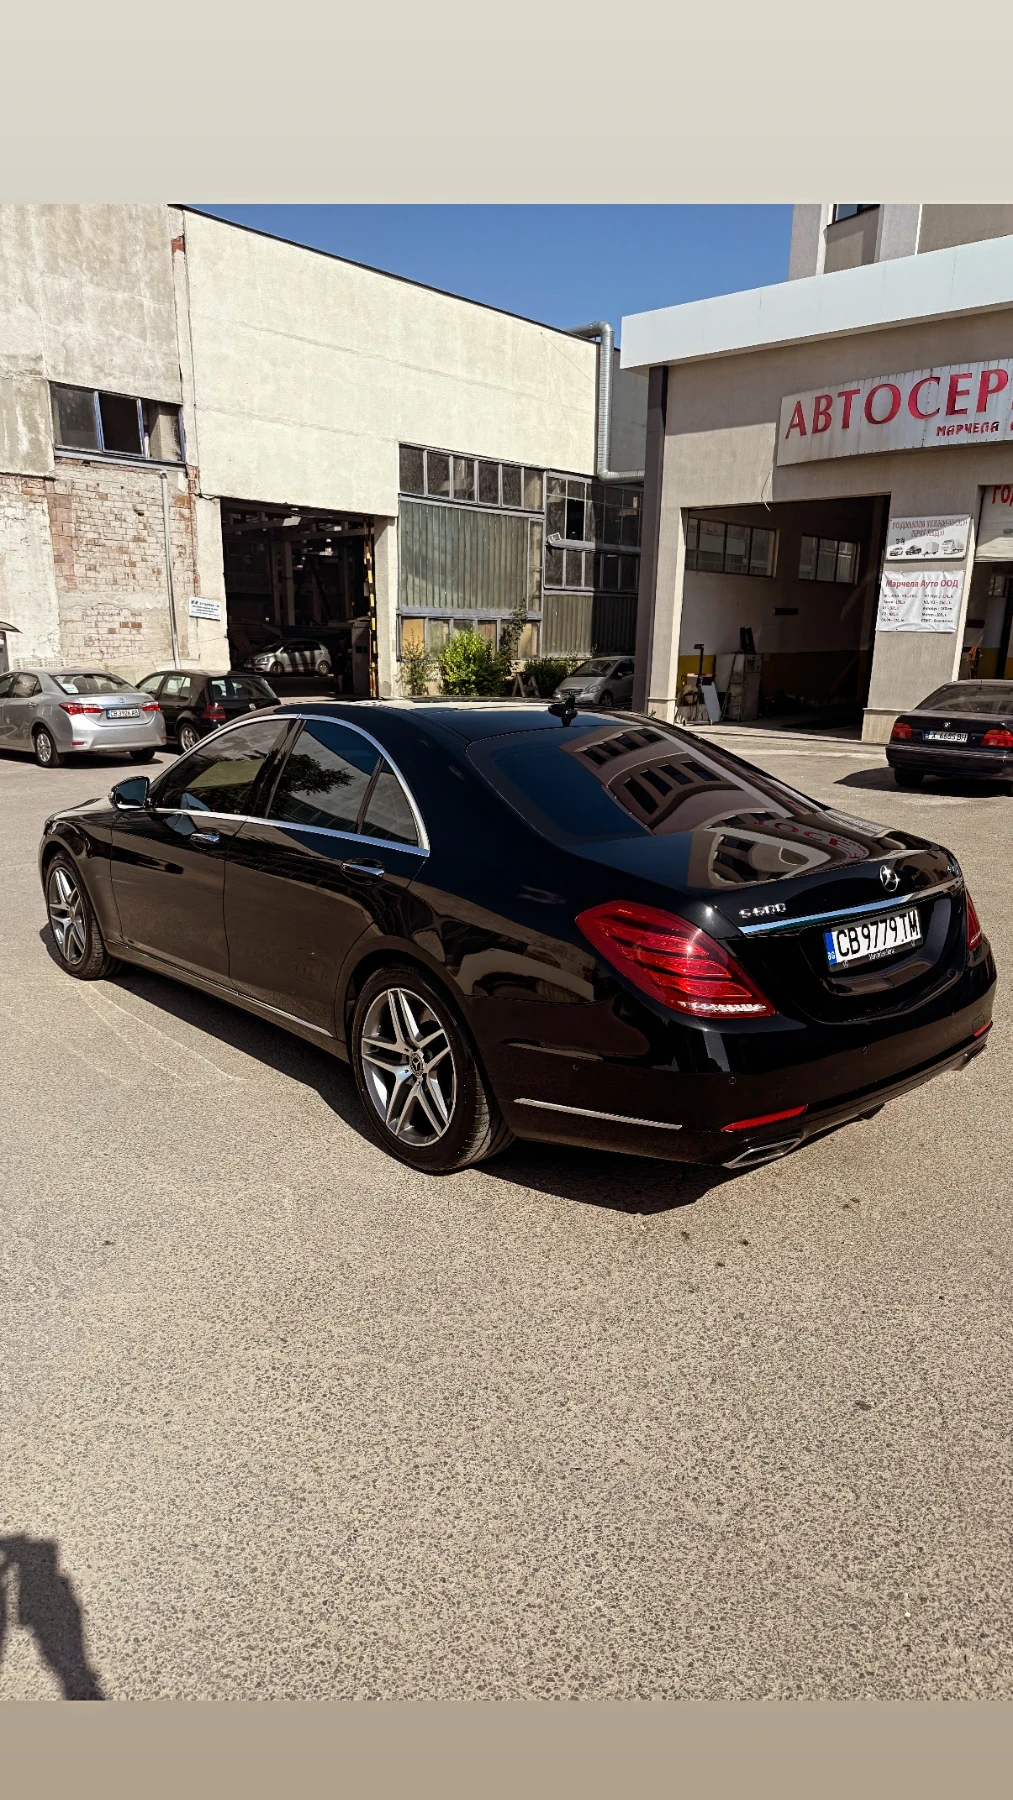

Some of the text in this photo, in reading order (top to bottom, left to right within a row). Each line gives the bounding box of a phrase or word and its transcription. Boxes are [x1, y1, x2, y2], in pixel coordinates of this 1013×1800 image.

[785, 369, 1013, 439] АВТОСЕР
[936, 421, 1000, 437] МАРЧЕЛА
[992, 484, 1013, 506] ГО
[885, 579, 959, 589] Марчела Ауто ООД
[827, 951, 836, 961] BG
[837, 926, 861, 957] CB
[861, 917, 898, 951] 9779
[899, 909, 919, 940] TM
